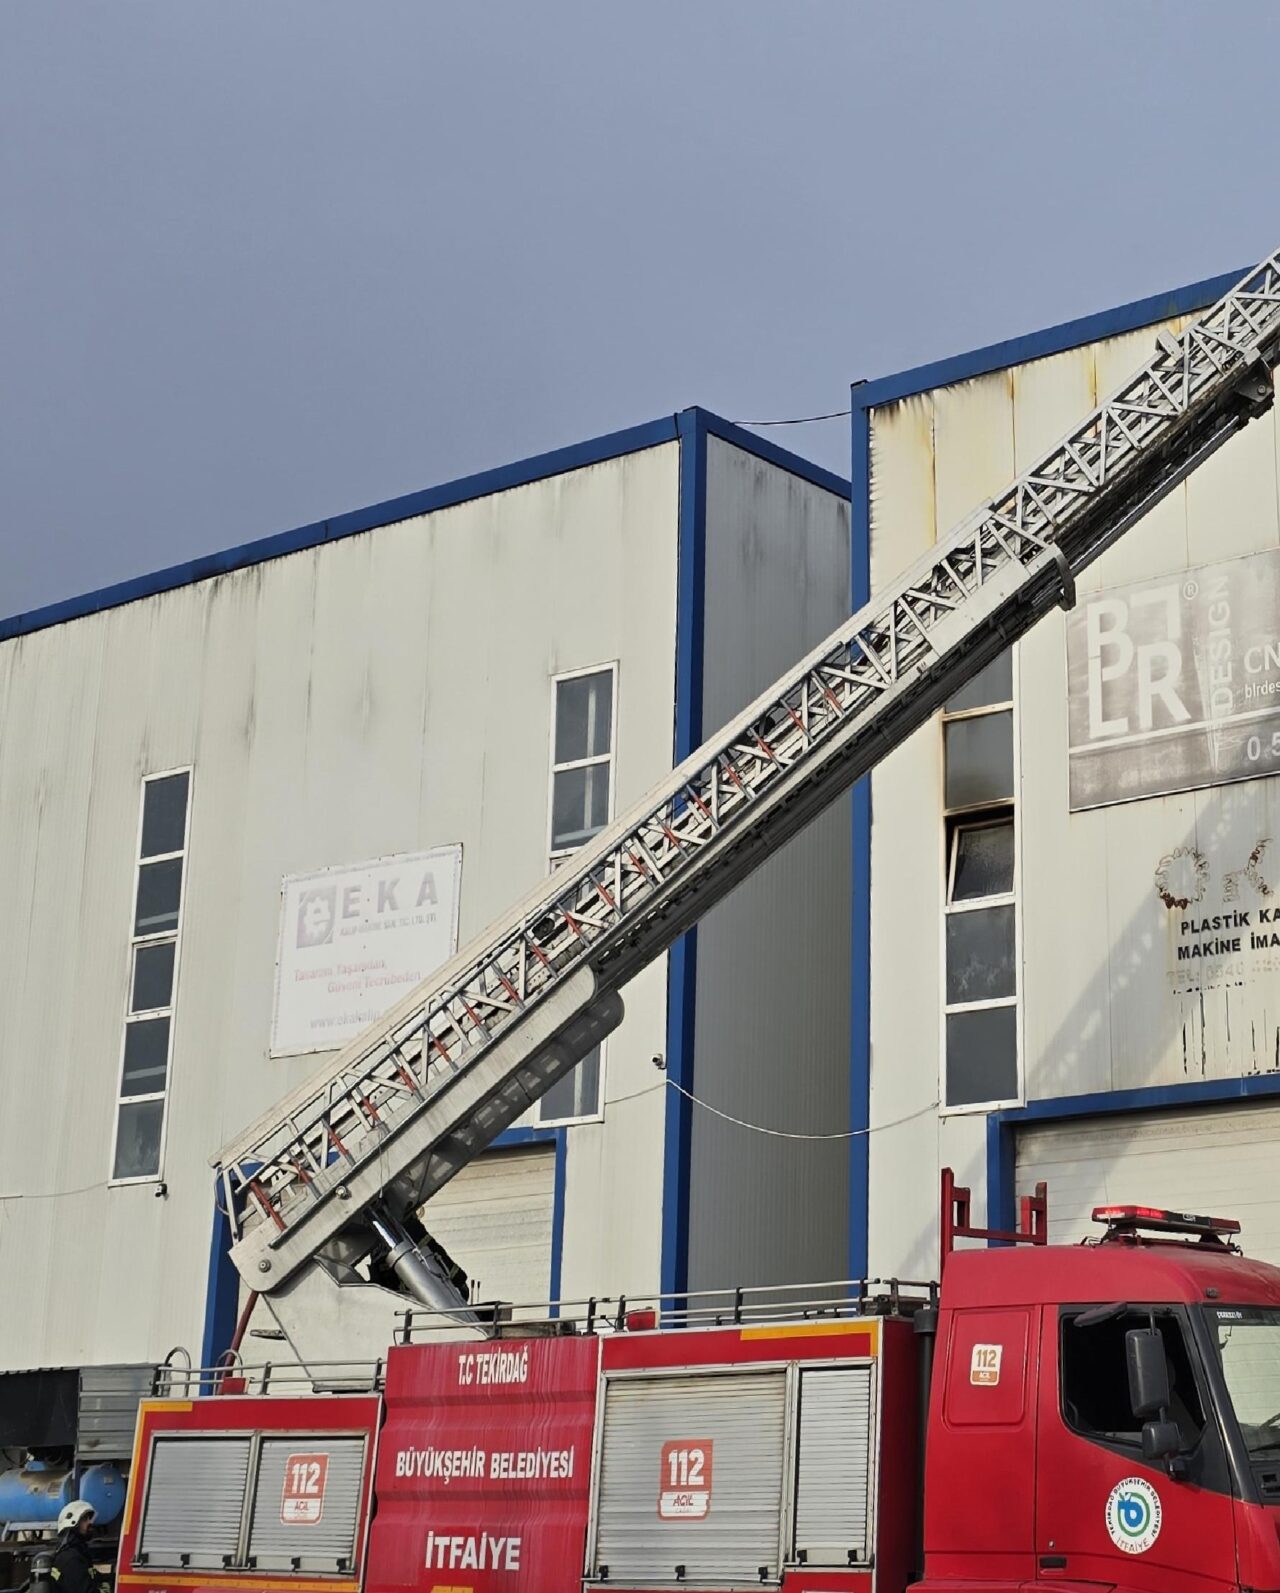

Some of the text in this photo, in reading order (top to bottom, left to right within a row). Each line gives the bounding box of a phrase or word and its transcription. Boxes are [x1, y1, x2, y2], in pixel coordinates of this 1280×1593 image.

[1208, 575, 1233, 716] DESIGN
[1246, 735, 1261, 761] 0
[342, 872, 438, 919] EKA
[1181, 910, 1250, 936] PLASTİK
[1177, 936, 1241, 961] MAKİNE
[476, 1345, 528, 1385] TEKİRDAĞ
[976, 1349, 997, 1367] 112
[291, 1461, 321, 1494] 112
[396, 1445, 574, 1484] BÜYÜKŞEHİR BELEDİYESİ
[668, 1449, 705, 1486] 112
[425, 1530, 522, 1571] İTFAİYE
[1116, 1536, 1150, 1553] İTFAİYE
